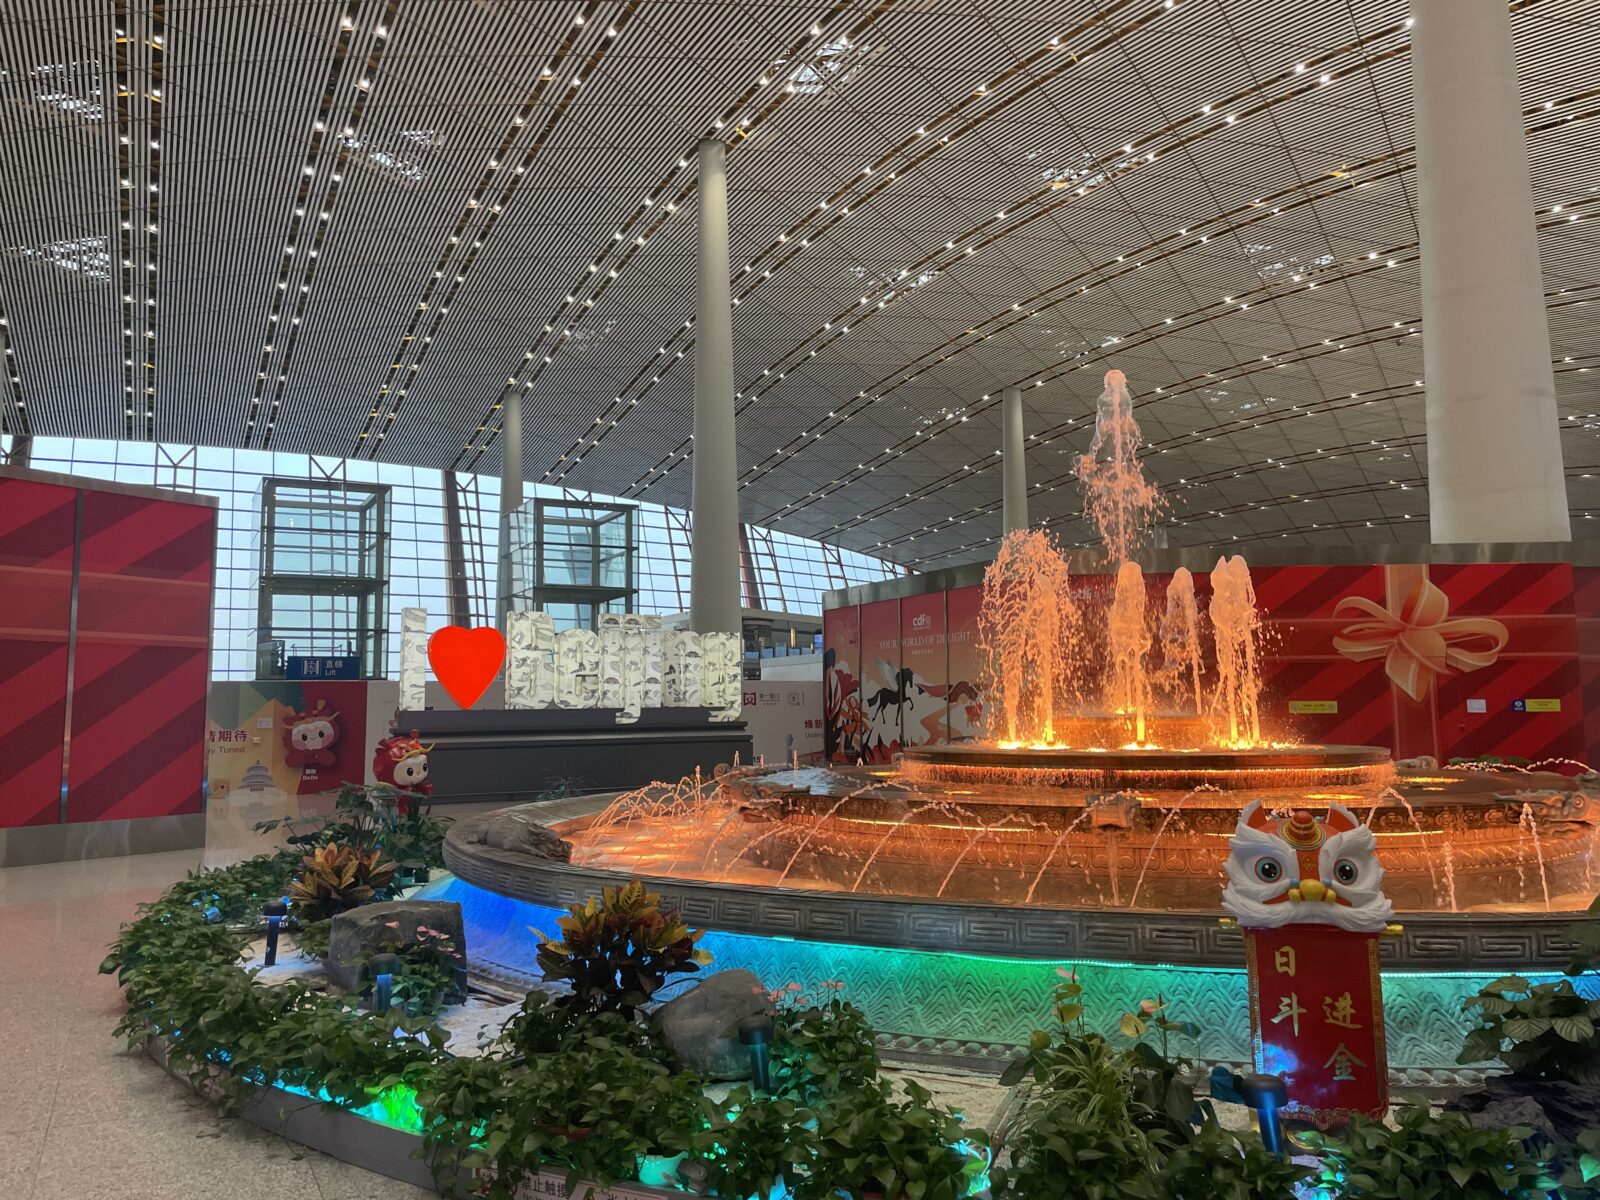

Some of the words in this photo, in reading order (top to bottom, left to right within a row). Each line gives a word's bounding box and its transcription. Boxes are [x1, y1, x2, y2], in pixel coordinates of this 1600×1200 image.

[912, 613, 926, 627] cdf
[879, 639, 898, 649] YOUR
[925, 634, 935, 645] OF
[325, 660, 343, 668] 直梯
[400, 608, 427, 711] I
[505, 611, 742, 724] Beijing
